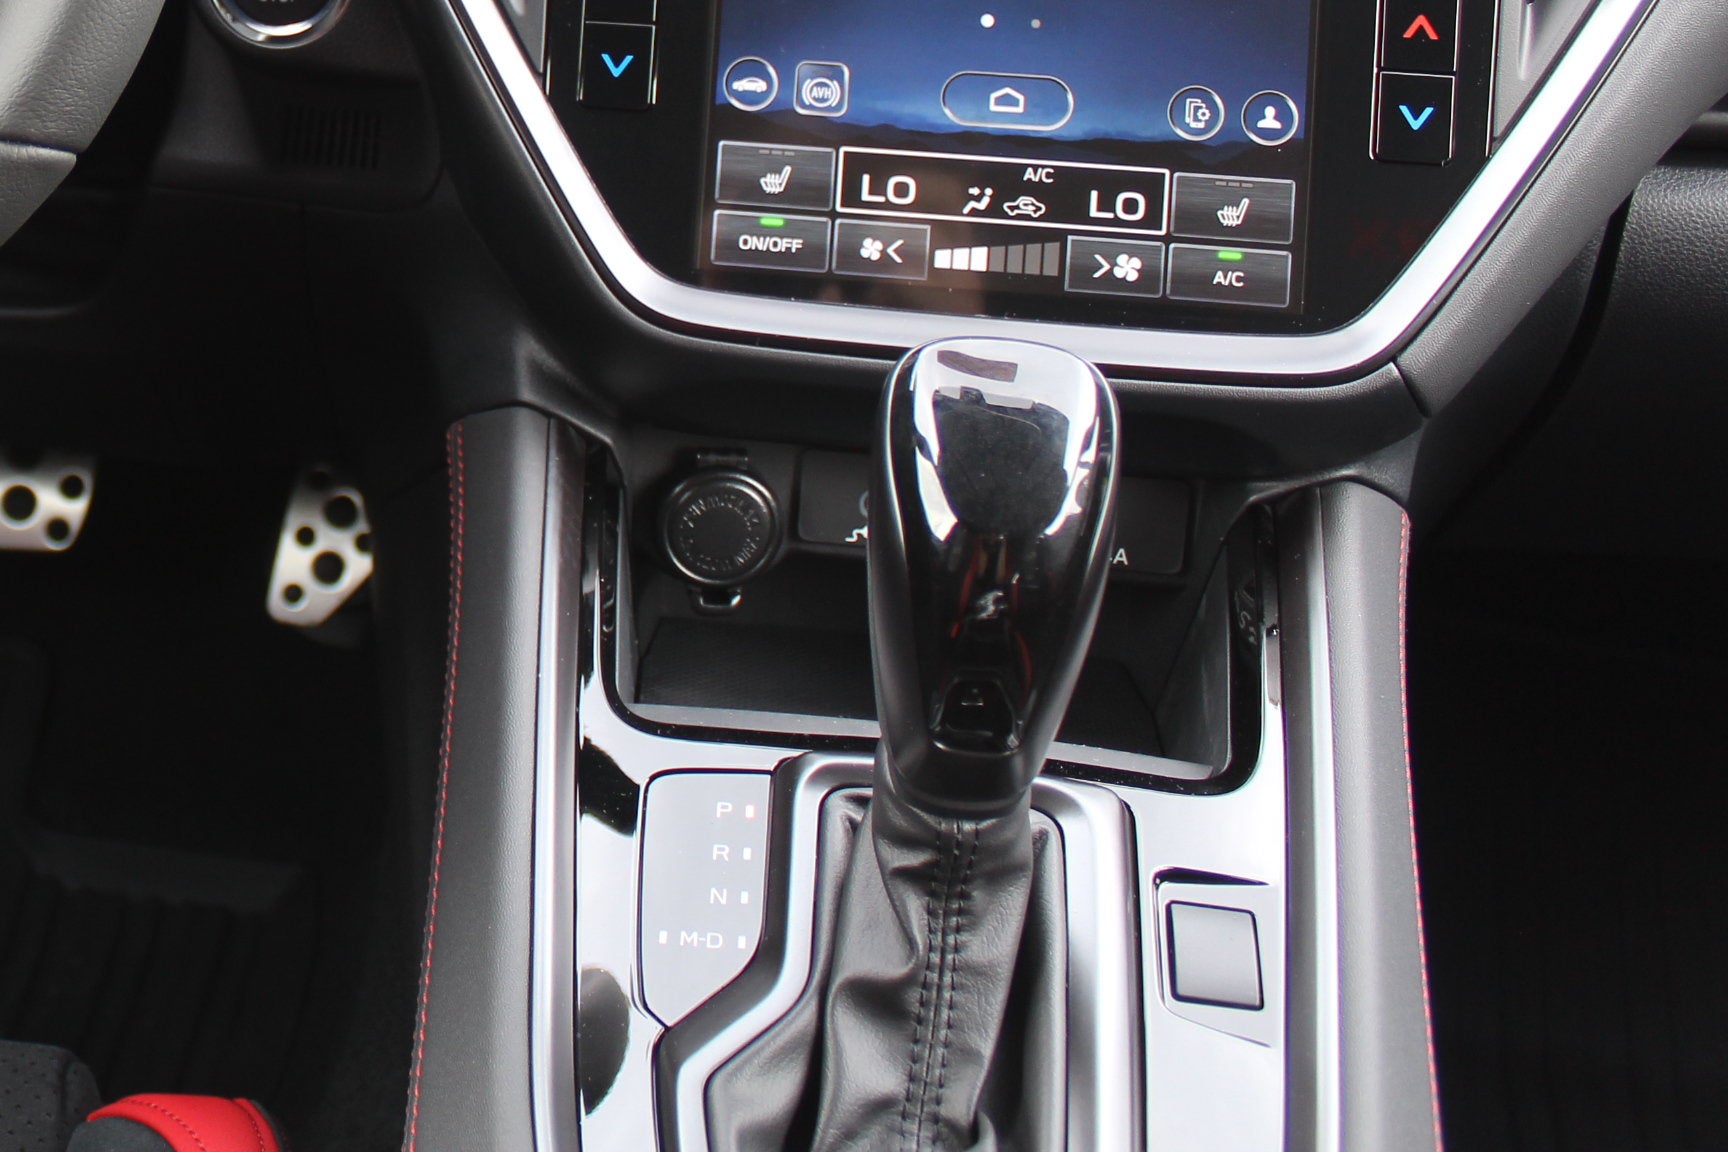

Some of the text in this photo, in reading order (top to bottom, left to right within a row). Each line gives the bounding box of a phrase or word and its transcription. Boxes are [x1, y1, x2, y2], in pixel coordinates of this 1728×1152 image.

[812, 87, 831, 99] AVH
[1023, 167, 1054, 183] A/C
[861, 173, 917, 204] LO
[1089, 190, 1145, 221] LO
[738, 234, 803, 255] ON/OFF
[1212, 269, 1245, 289] A/C
[716, 802, 733, 818] P
[712, 844, 730, 861] R
[709, 887, 728, 904] N
[679, 931, 723, 949] M-D
